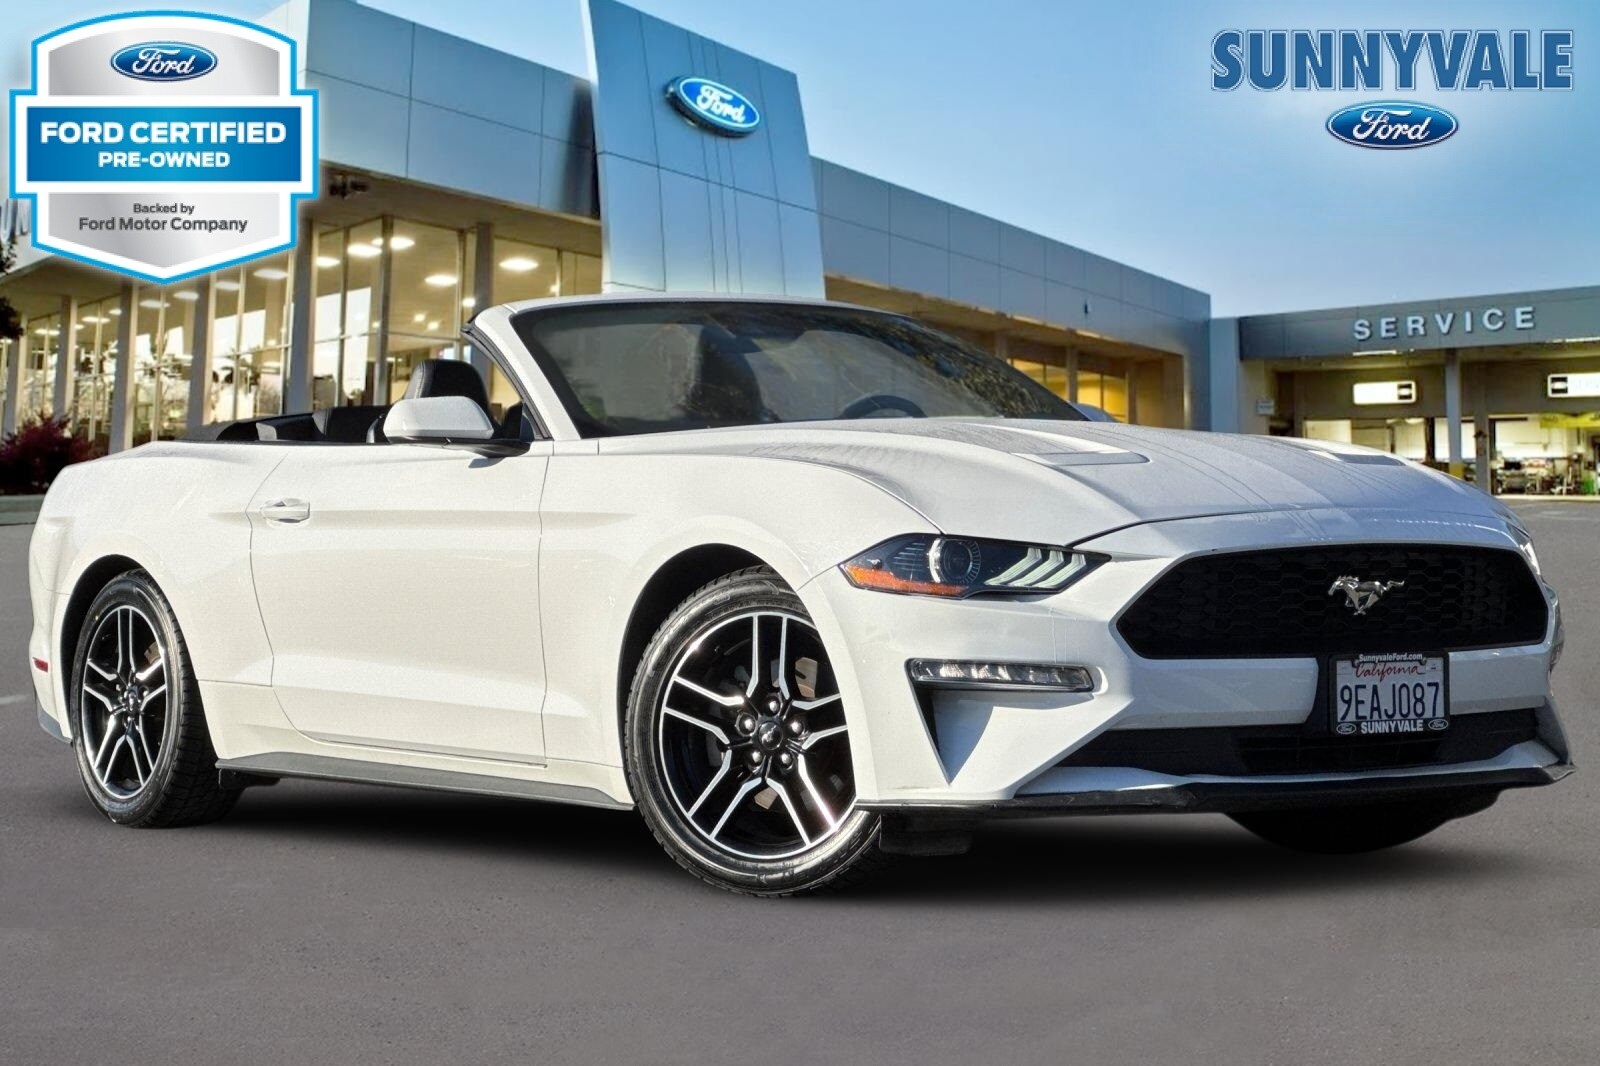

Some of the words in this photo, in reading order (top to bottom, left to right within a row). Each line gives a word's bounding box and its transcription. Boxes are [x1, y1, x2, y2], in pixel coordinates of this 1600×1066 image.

[696, 84, 746, 123] Ford
[1353, 306, 1536, 341] SERVICE
[1359, 652, 1423, 662] SunnyvaleFord.com
[1355, 661, 1426, 682] California
[1340, 682, 1440, 721] 9EAJ087
[1360, 719, 1424, 734] SUNNYVALE
